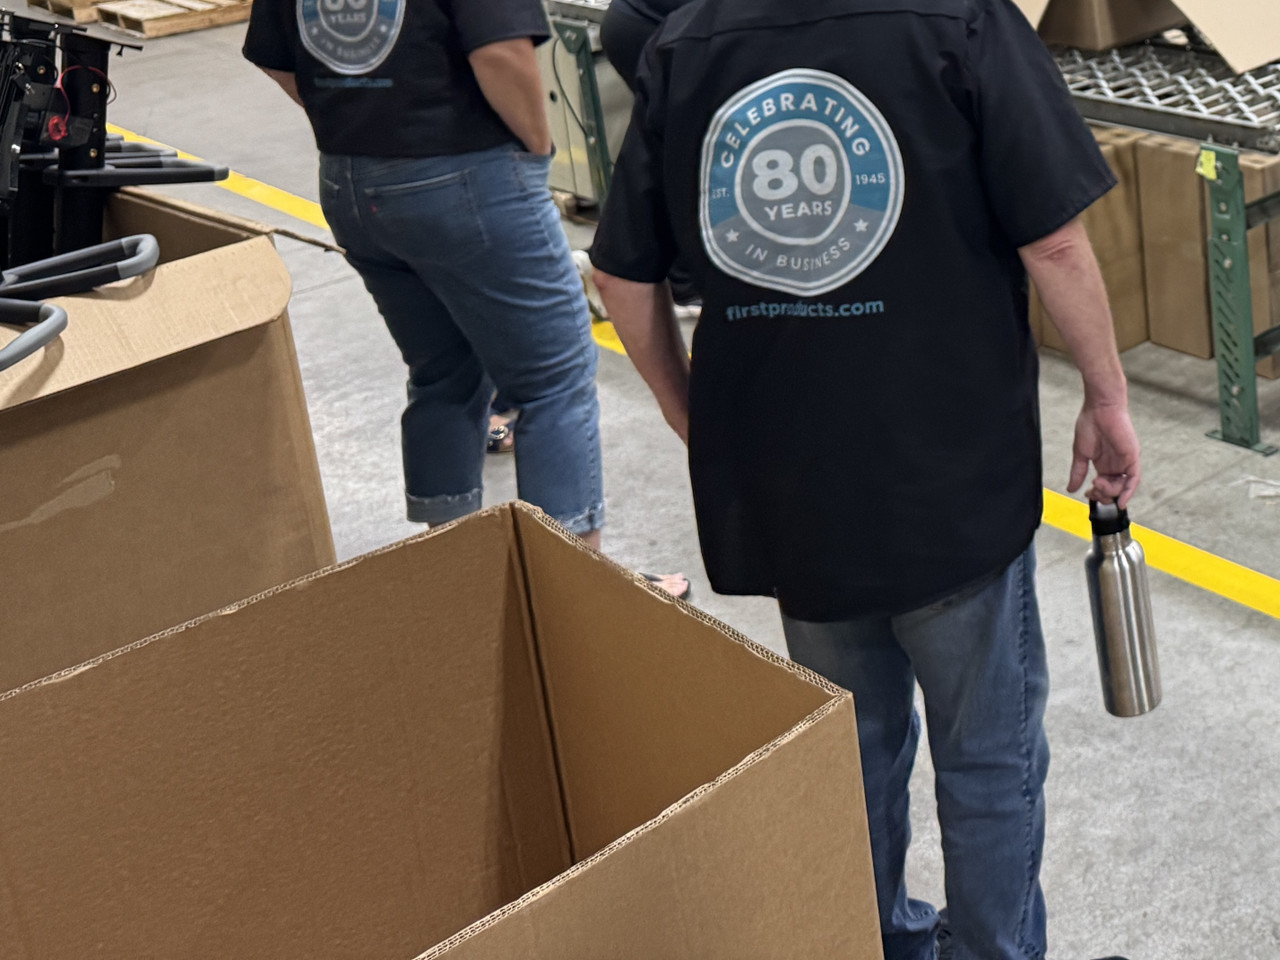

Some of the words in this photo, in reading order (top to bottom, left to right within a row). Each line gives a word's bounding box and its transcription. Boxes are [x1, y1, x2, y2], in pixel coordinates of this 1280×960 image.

[720, 92, 870, 169] CELEBRATING
[751, 143, 838, 200] 80
[855, 173, 886, 185] 1945
[764, 200, 833, 222] YEARS
[745, 243, 769, 261] IN
[776, 237, 850, 271] BUSINESS
